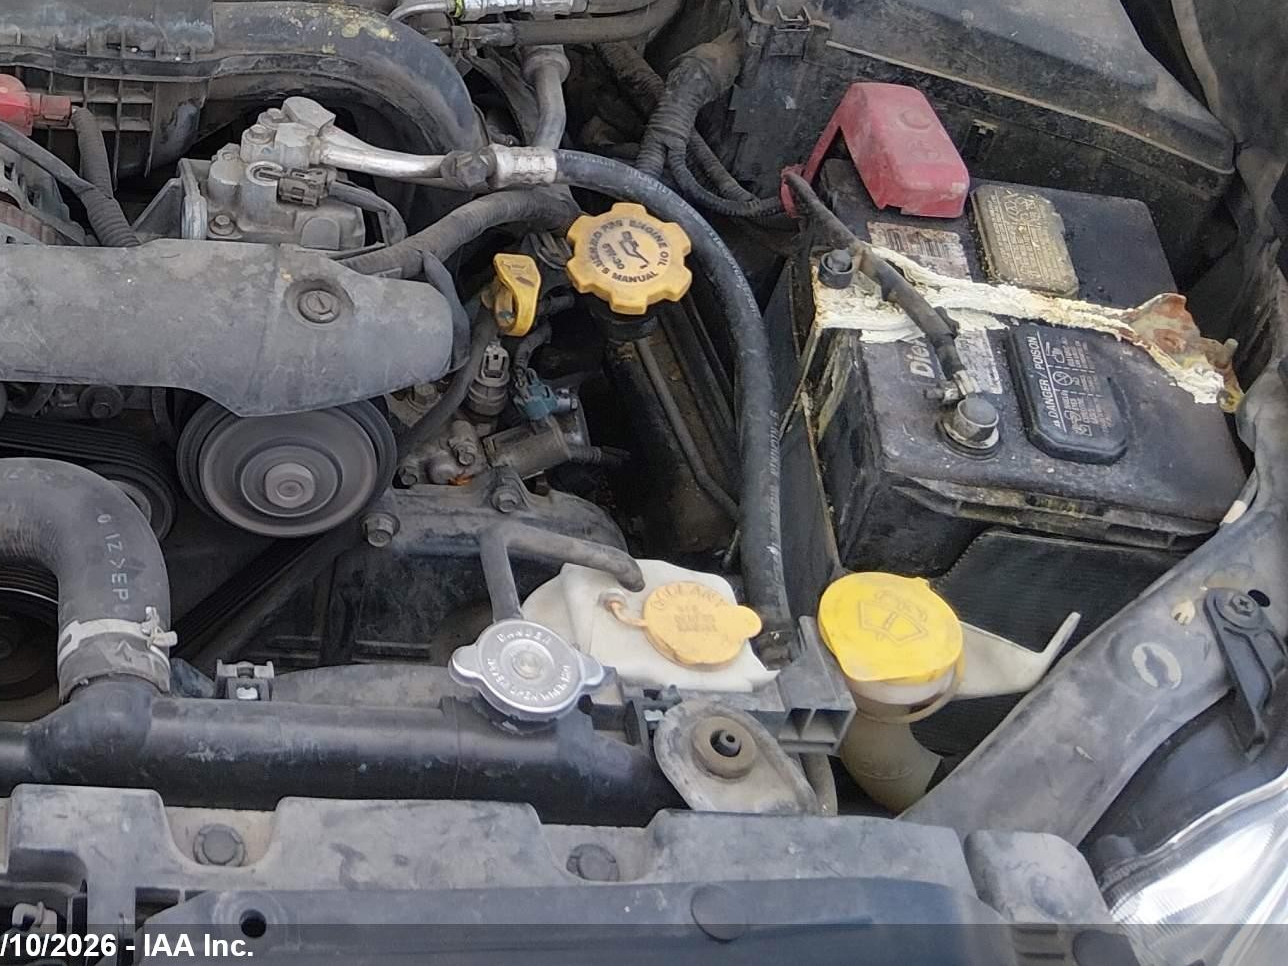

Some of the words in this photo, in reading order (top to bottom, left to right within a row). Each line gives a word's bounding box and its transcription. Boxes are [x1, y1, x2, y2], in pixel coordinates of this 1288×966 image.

[629, 219, 668, 248] ENGINE
[657, 250, 670, 266] OIL
[612, 270, 659, 283] MANUAL
[1026, 336, 1045, 370] POISON
[1038, 379, 1059, 419] DANGER
